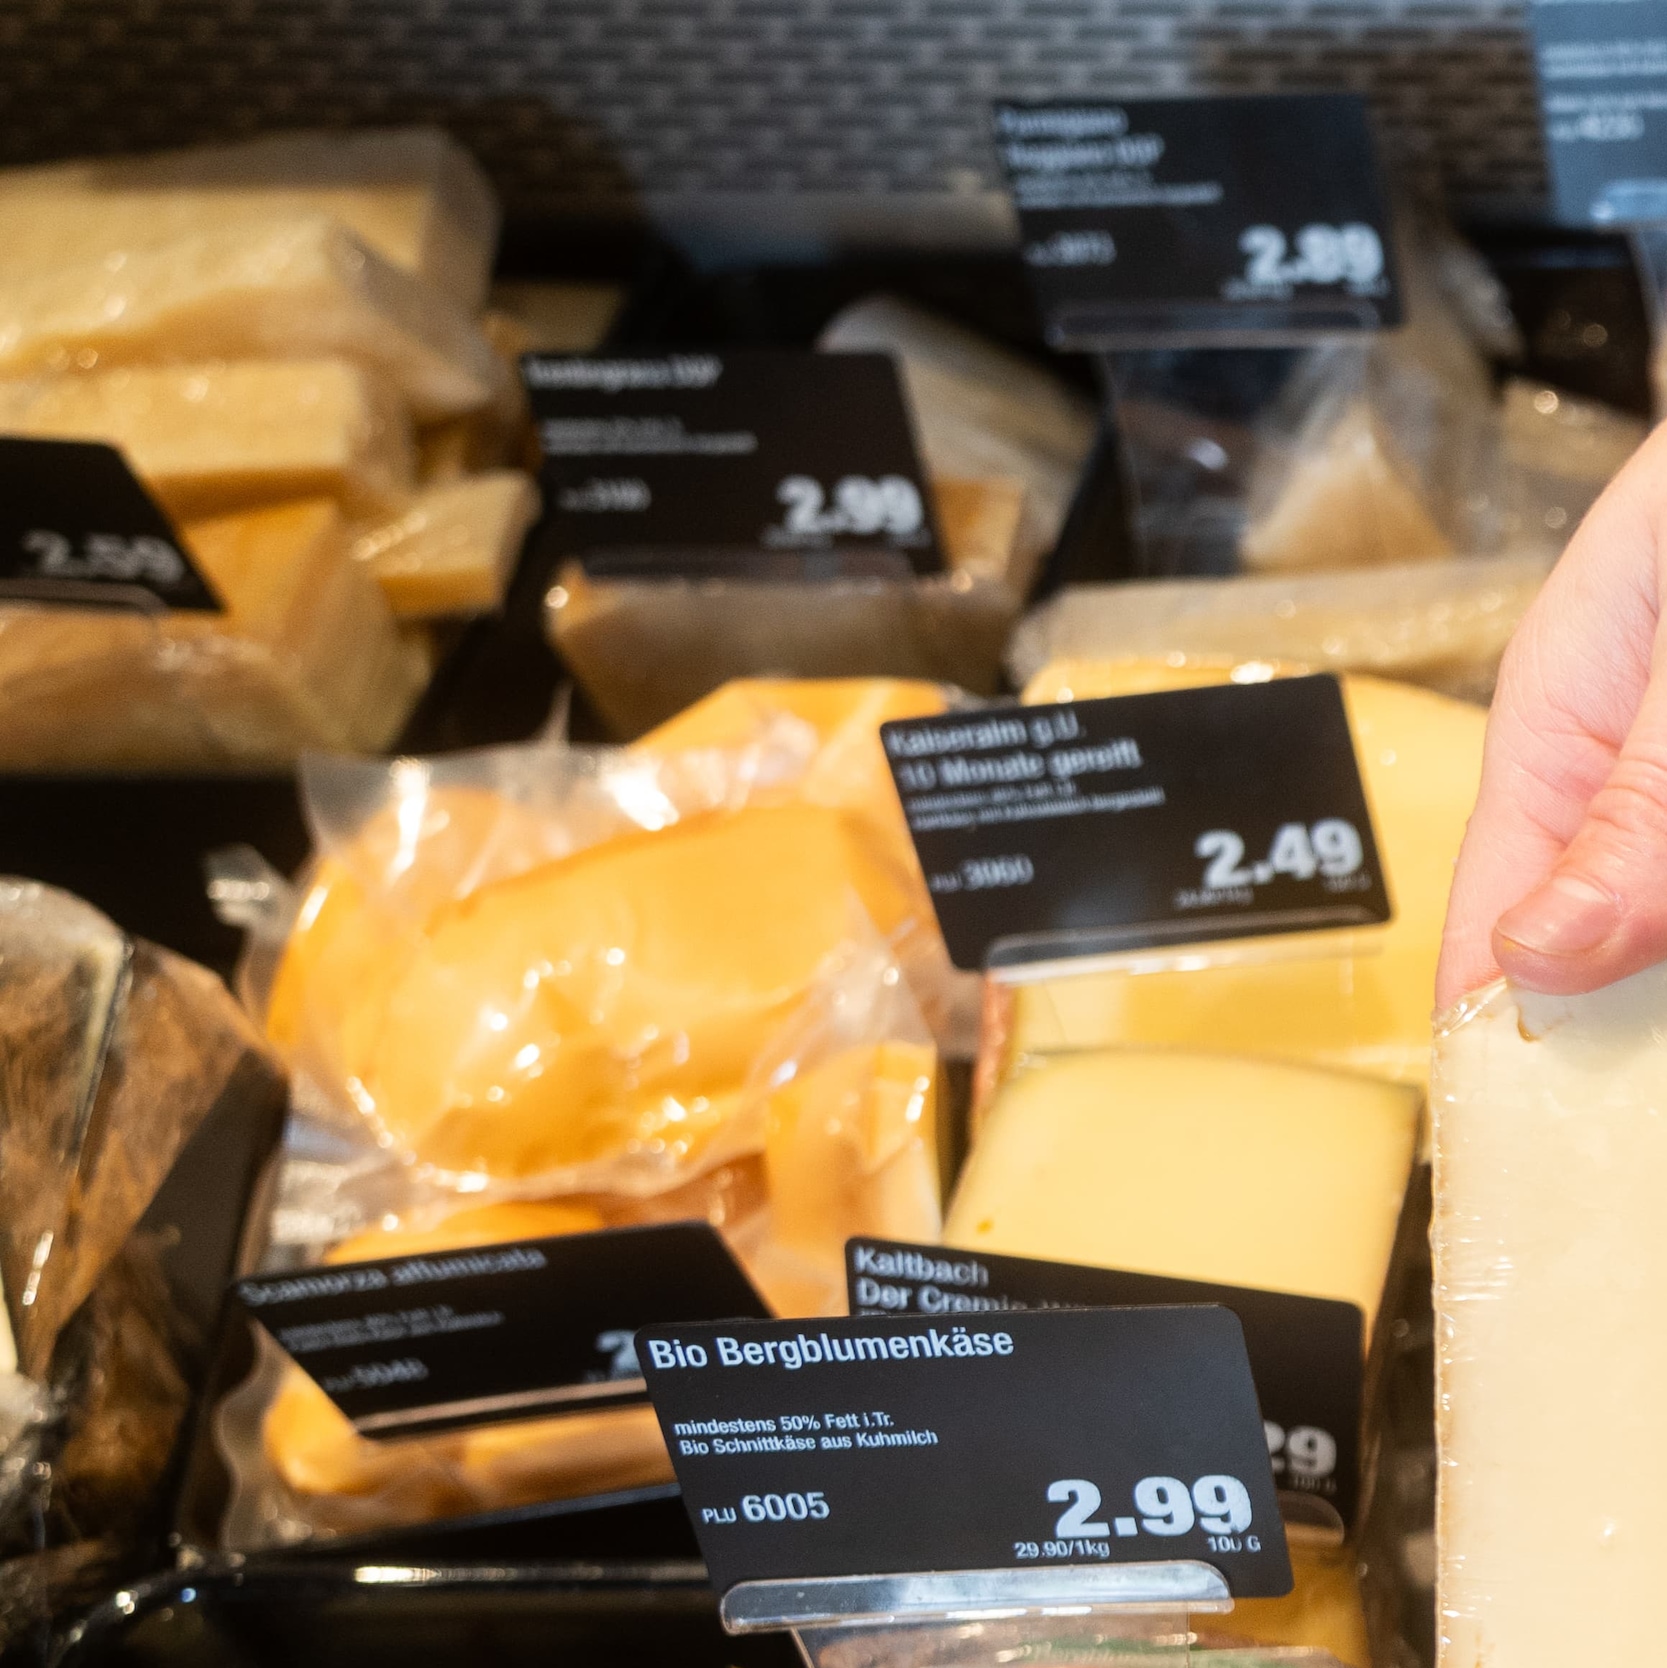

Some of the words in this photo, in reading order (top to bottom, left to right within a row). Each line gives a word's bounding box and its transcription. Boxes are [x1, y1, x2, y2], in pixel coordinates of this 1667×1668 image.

[940, 750, 1044, 786] Monate
[1197, 817, 1363, 889] 2.49
[854, 1246, 988, 1288] Kaltbach
[857, 1277, 912, 1309] Der
[648, 1338, 708, 1370] Bio
[717, 1327, 1014, 1370] Bergblumenkäse
[674, 1417, 776, 1435] mindestens
[780, 1415, 821, 1432] 50%
[824, 1413, 860, 1430] Fett
[680, 1440, 709, 1456] Bio
[714, 1435, 816, 1454] Schnittkäse
[821, 1434, 852, 1449] aus
[855, 1429, 938, 1448] Kuhmilch
[702, 1507, 737, 1525] PLU
[742, 1491, 830, 1522] 6005
[1047, 1474, 1252, 1538] 2.99
[1013, 1539, 1110, 1559] 29.90/1kg
